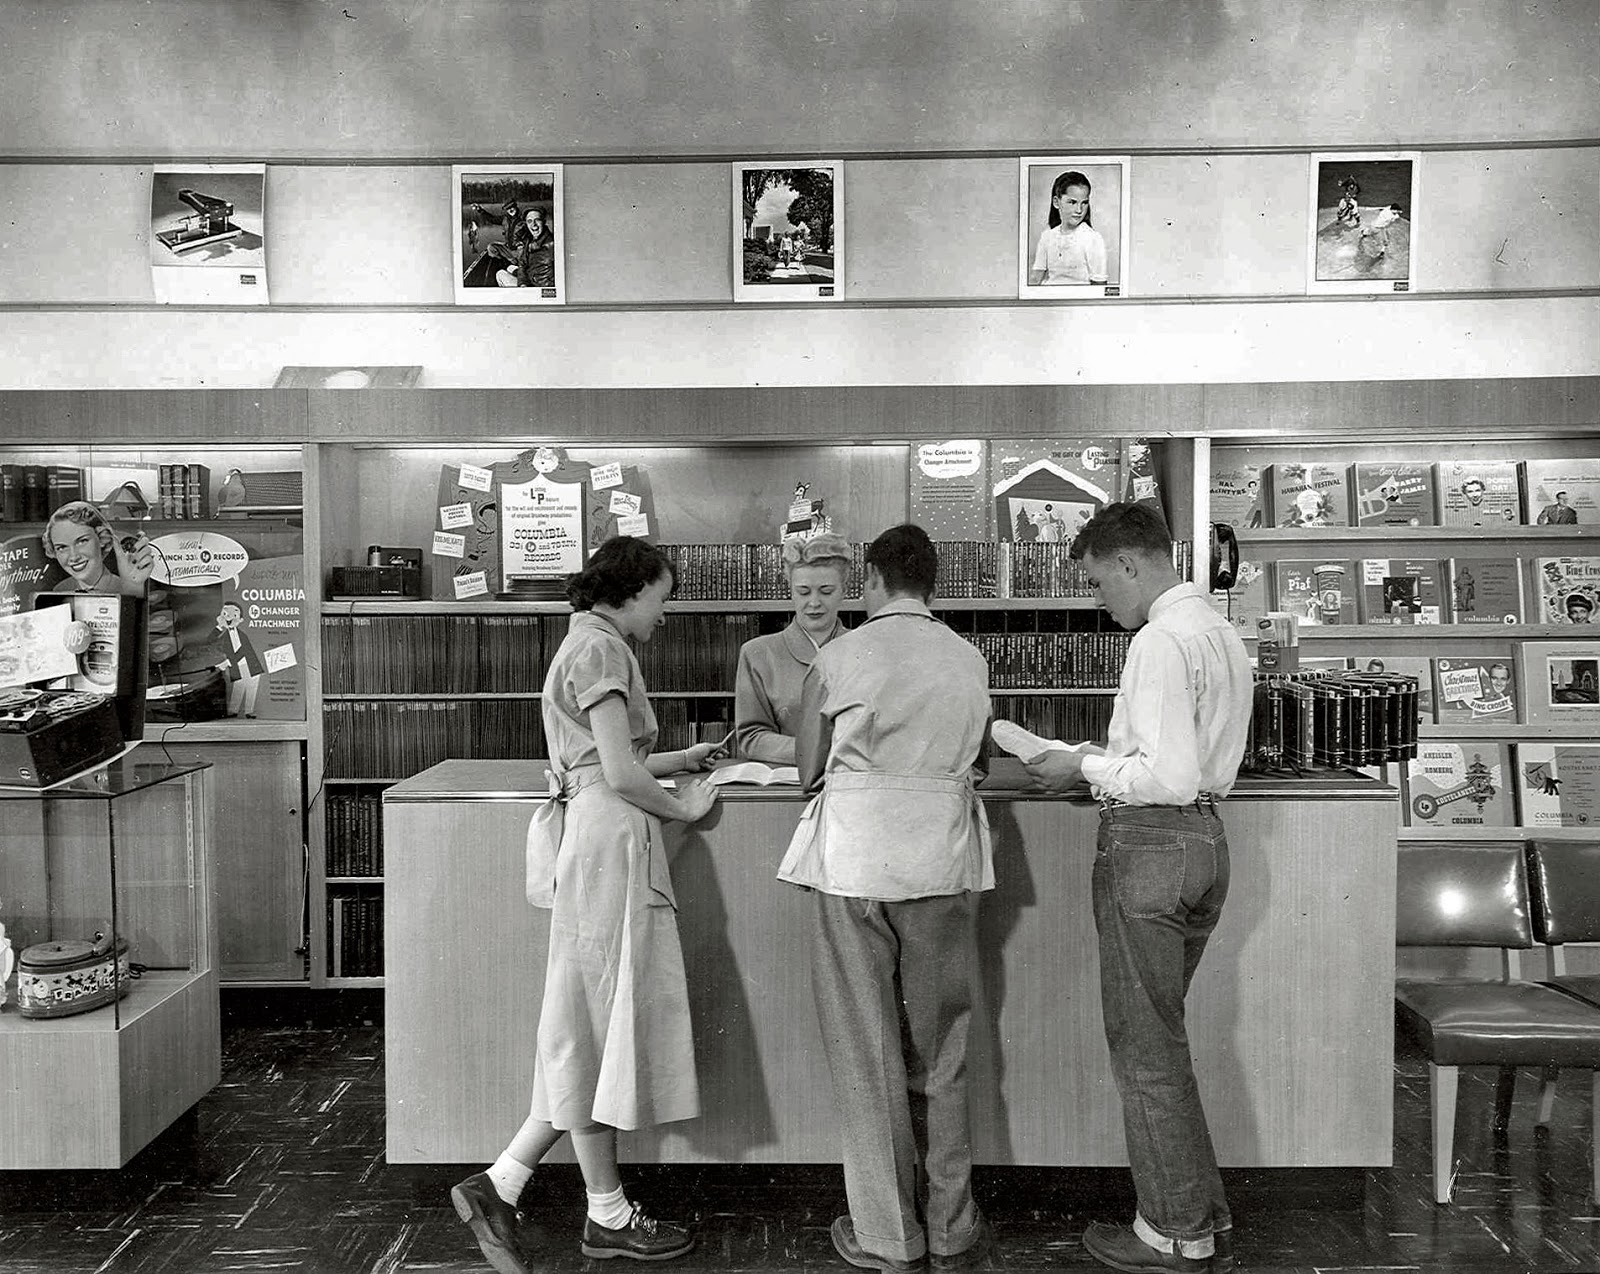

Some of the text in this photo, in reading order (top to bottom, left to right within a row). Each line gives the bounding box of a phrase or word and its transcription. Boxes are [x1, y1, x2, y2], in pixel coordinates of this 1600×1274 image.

[1087, 450, 1110, 460] LASTING
[1314, 479, 1342, 489] FESTIVAL
[1400, 485, 1426, 494] JAMES
[514, 527, 567, 540] COLUMBIA
[165, 553, 183, 561] INCH
[213, 553, 245, 561] RECORDS
[524, 552, 561, 562] RECORDS
[165, 565, 221, 578] AUTOMATICALLY
[1566, 564, 1582, 576] Bing
[1288, 577, 1311, 591] Piaf
[241, 588, 306, 601] COLUMBIA
[261, 607, 300, 616] CHANGER
[1464, 614, 1500, 623] columbia
[249, 620, 300, 628] ATTACHMENT
[1444, 672, 1478, 686] Christmas
[1470, 700, 1509, 710] BING CROSBY
